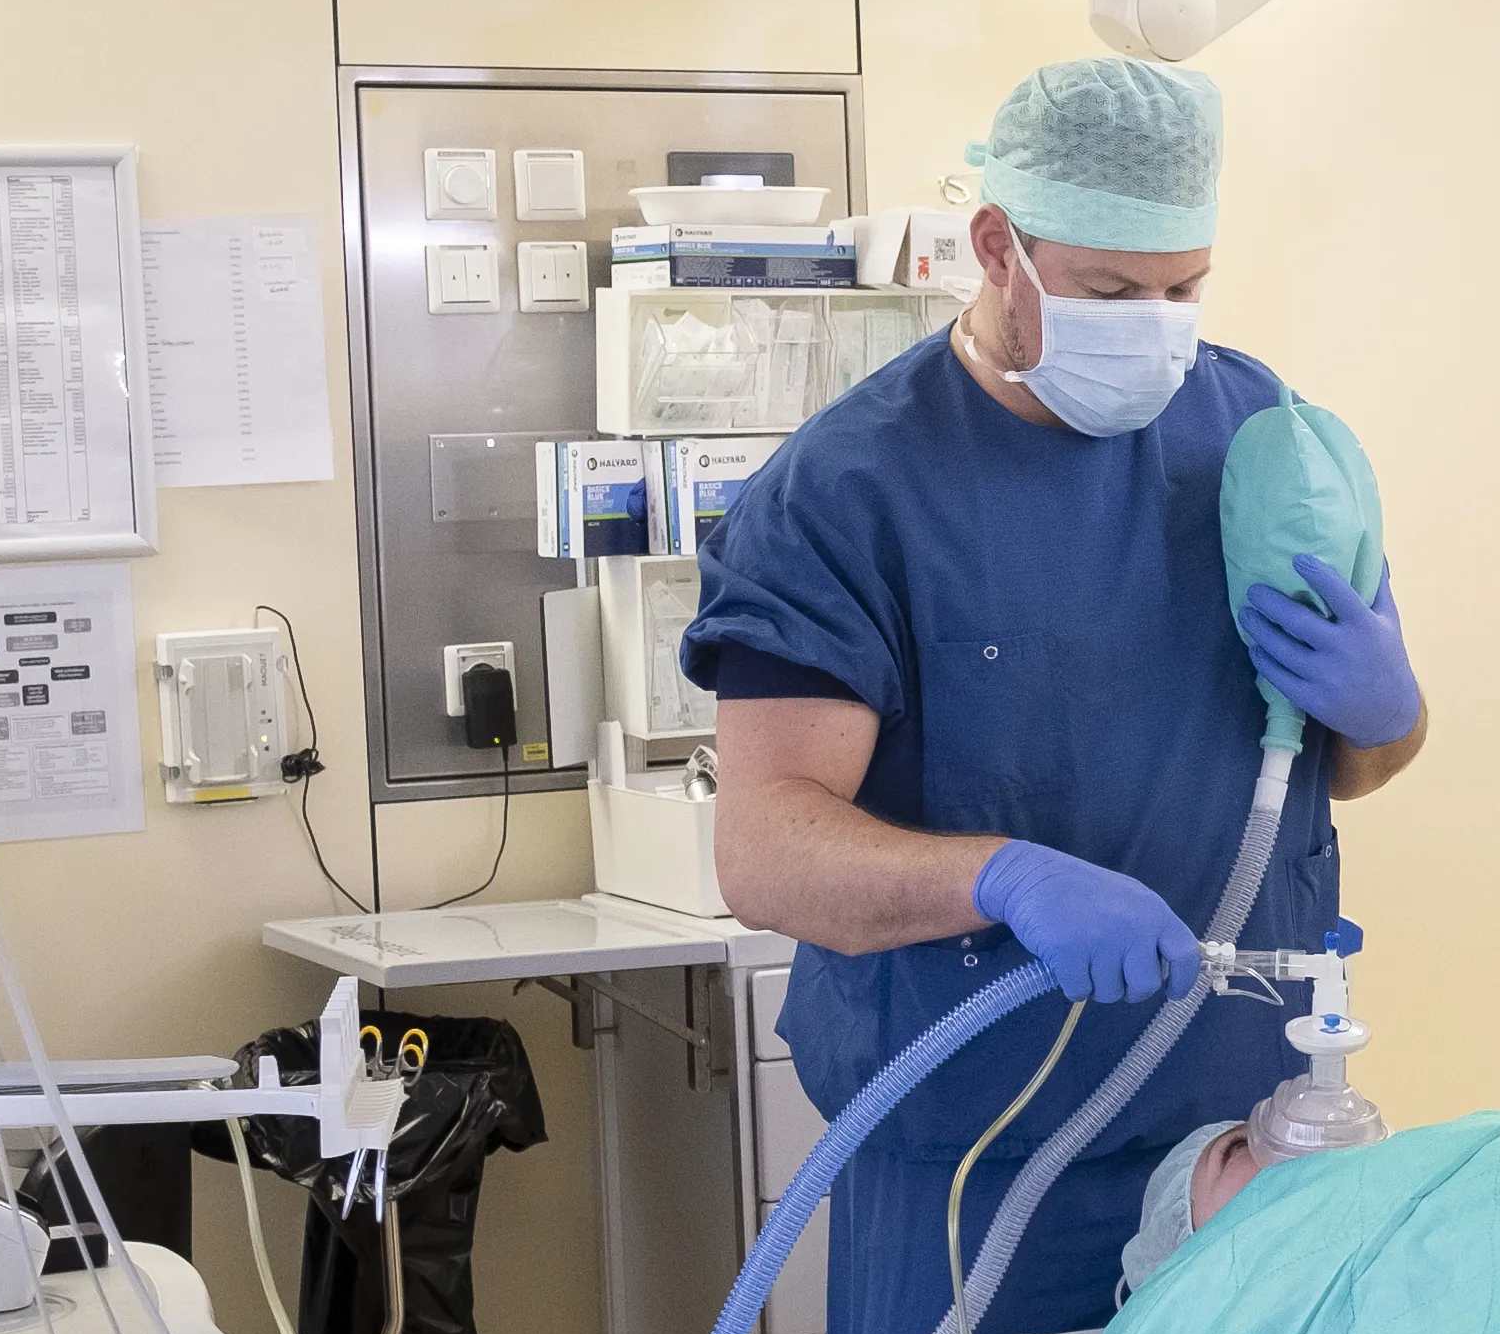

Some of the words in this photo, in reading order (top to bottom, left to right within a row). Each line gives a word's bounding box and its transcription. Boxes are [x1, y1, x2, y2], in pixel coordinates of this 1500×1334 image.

[917, 256, 930, 281] 3M
[599, 458, 638, 468] HALYARD
[711, 455, 747, 465] HALYARD
